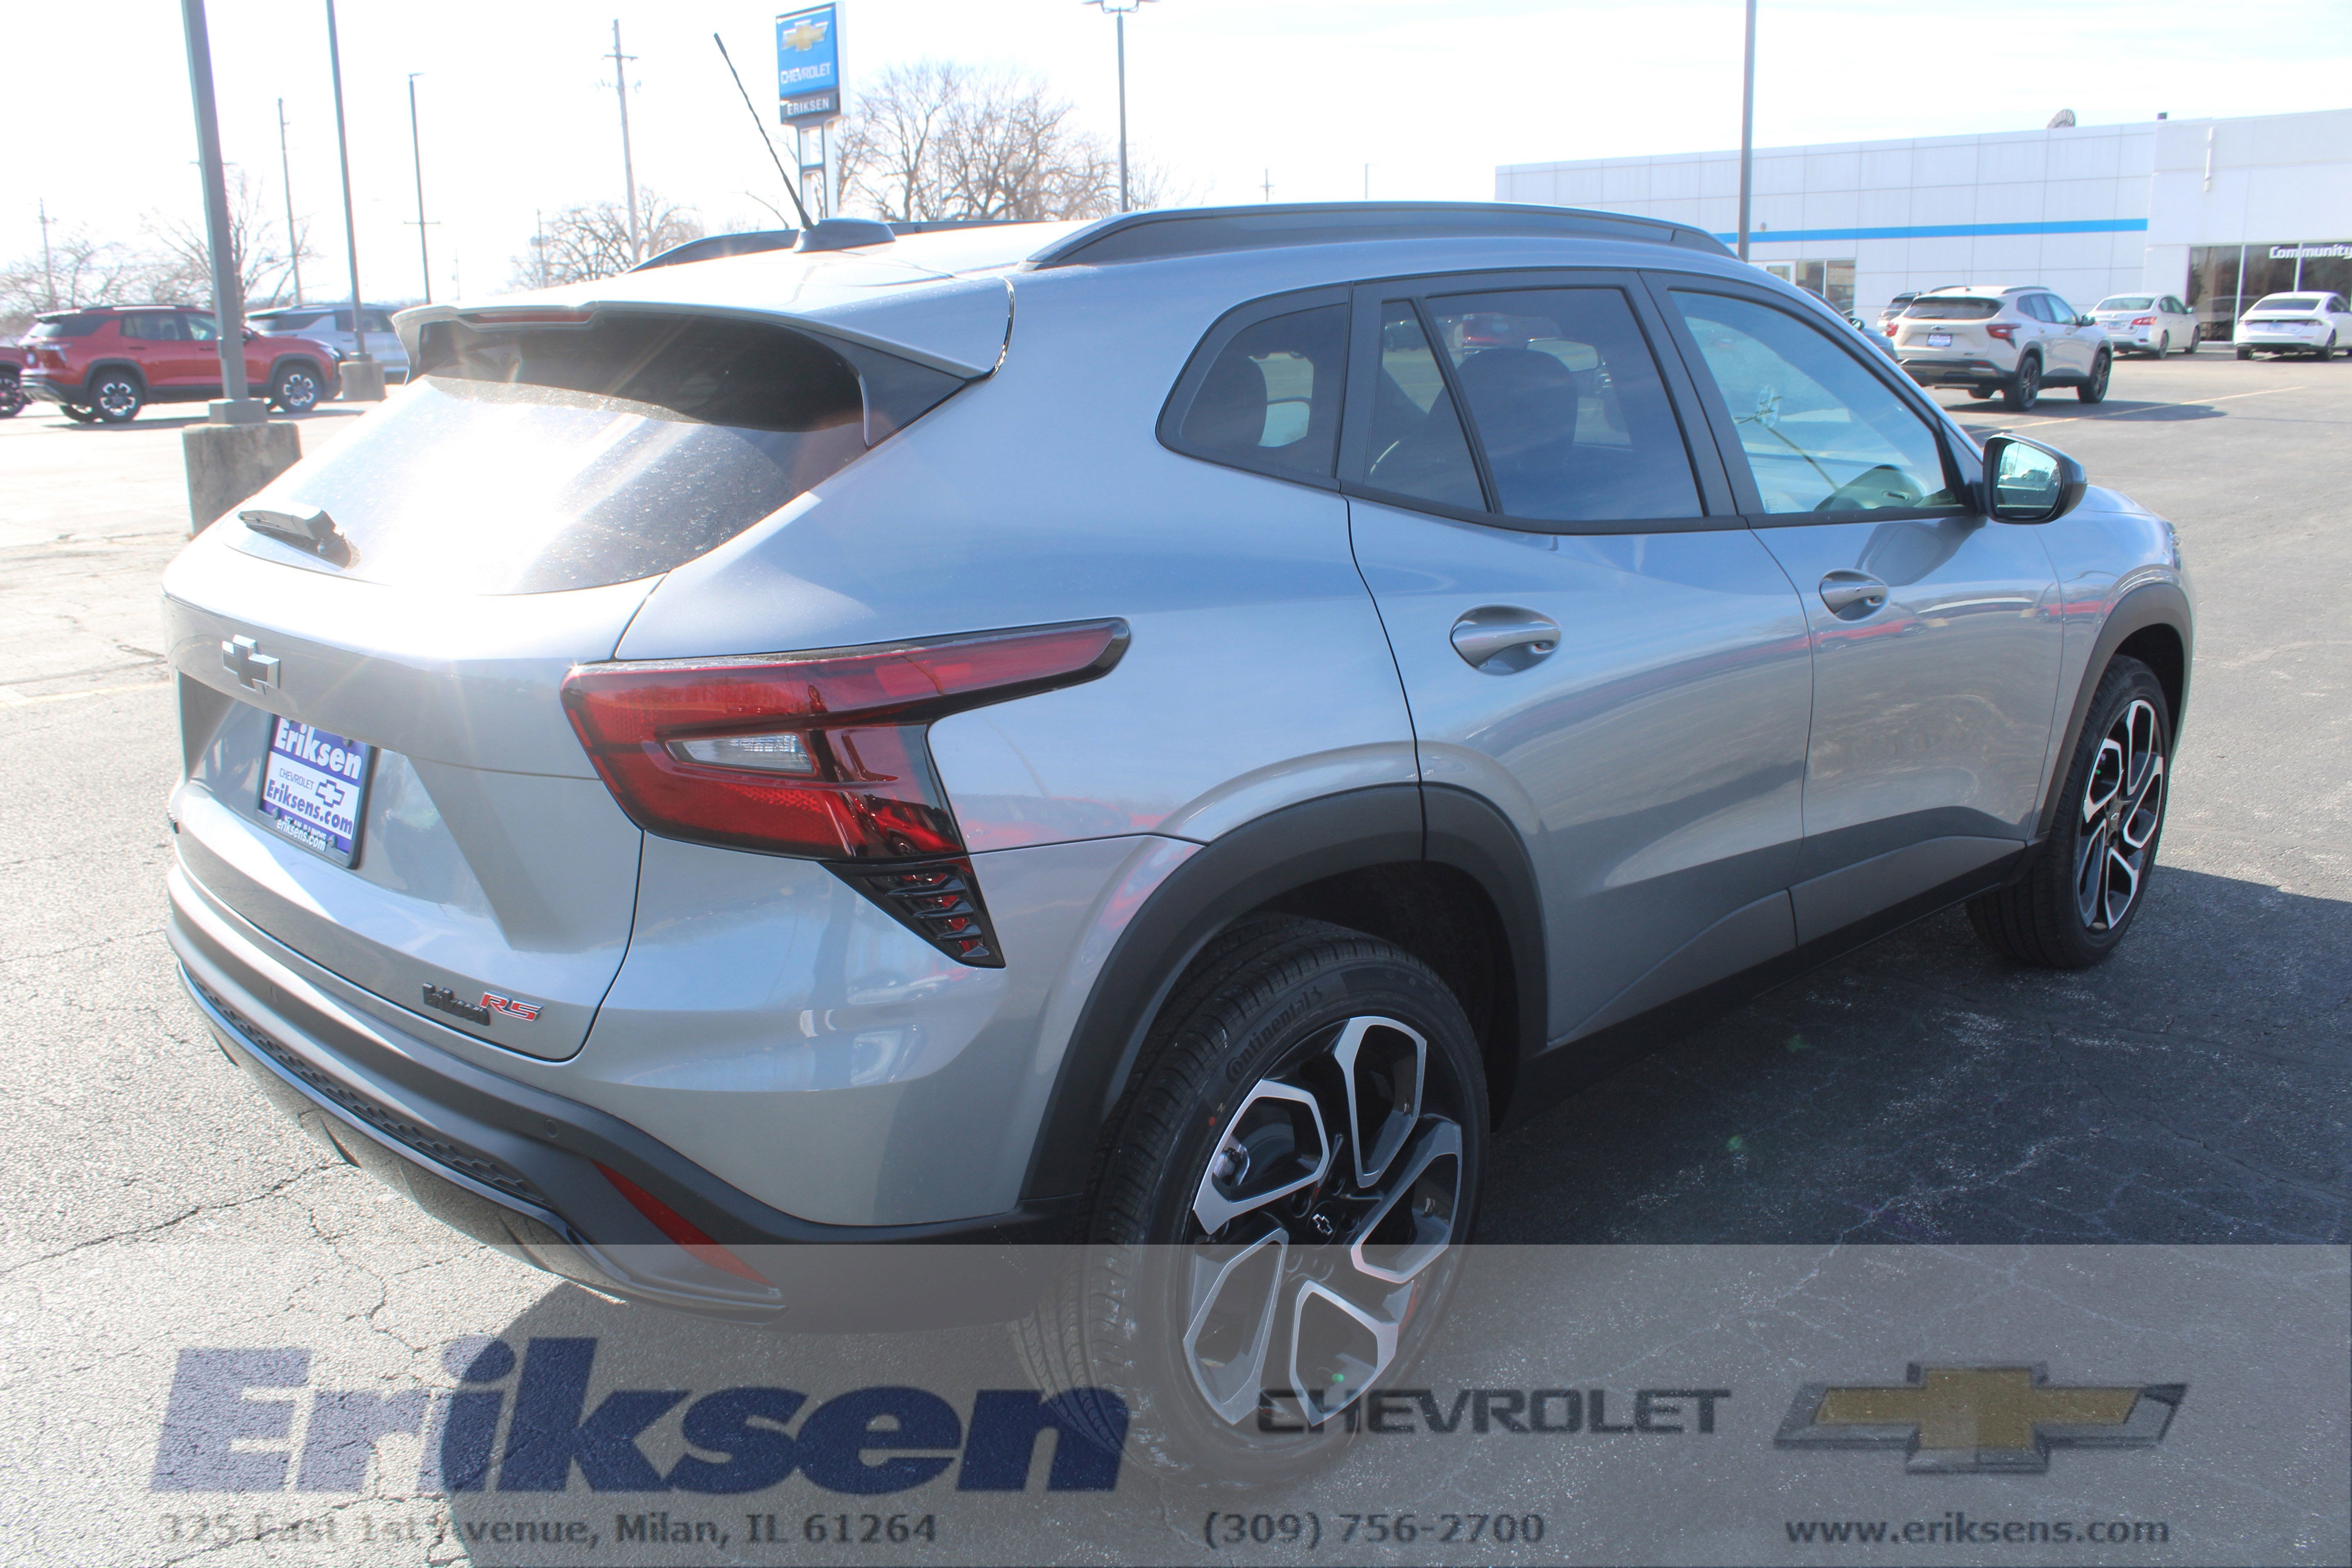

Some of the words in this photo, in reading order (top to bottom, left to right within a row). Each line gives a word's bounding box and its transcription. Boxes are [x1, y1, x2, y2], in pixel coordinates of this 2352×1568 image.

[780, 62, 831, 84] CHEVROLET
[787, 98, 830, 116] ERIKSEN
[2269, 244, 2352, 260] Community
[274, 717, 363, 780] Eriksen
[279, 768, 315, 790] CHEVROLET
[266, 779, 353, 835] Eriksens.com
[276, 819, 327, 852] eriksens.com
[480, 990, 546, 1021] RS
[1226, 991, 1311, 1084] Continental
